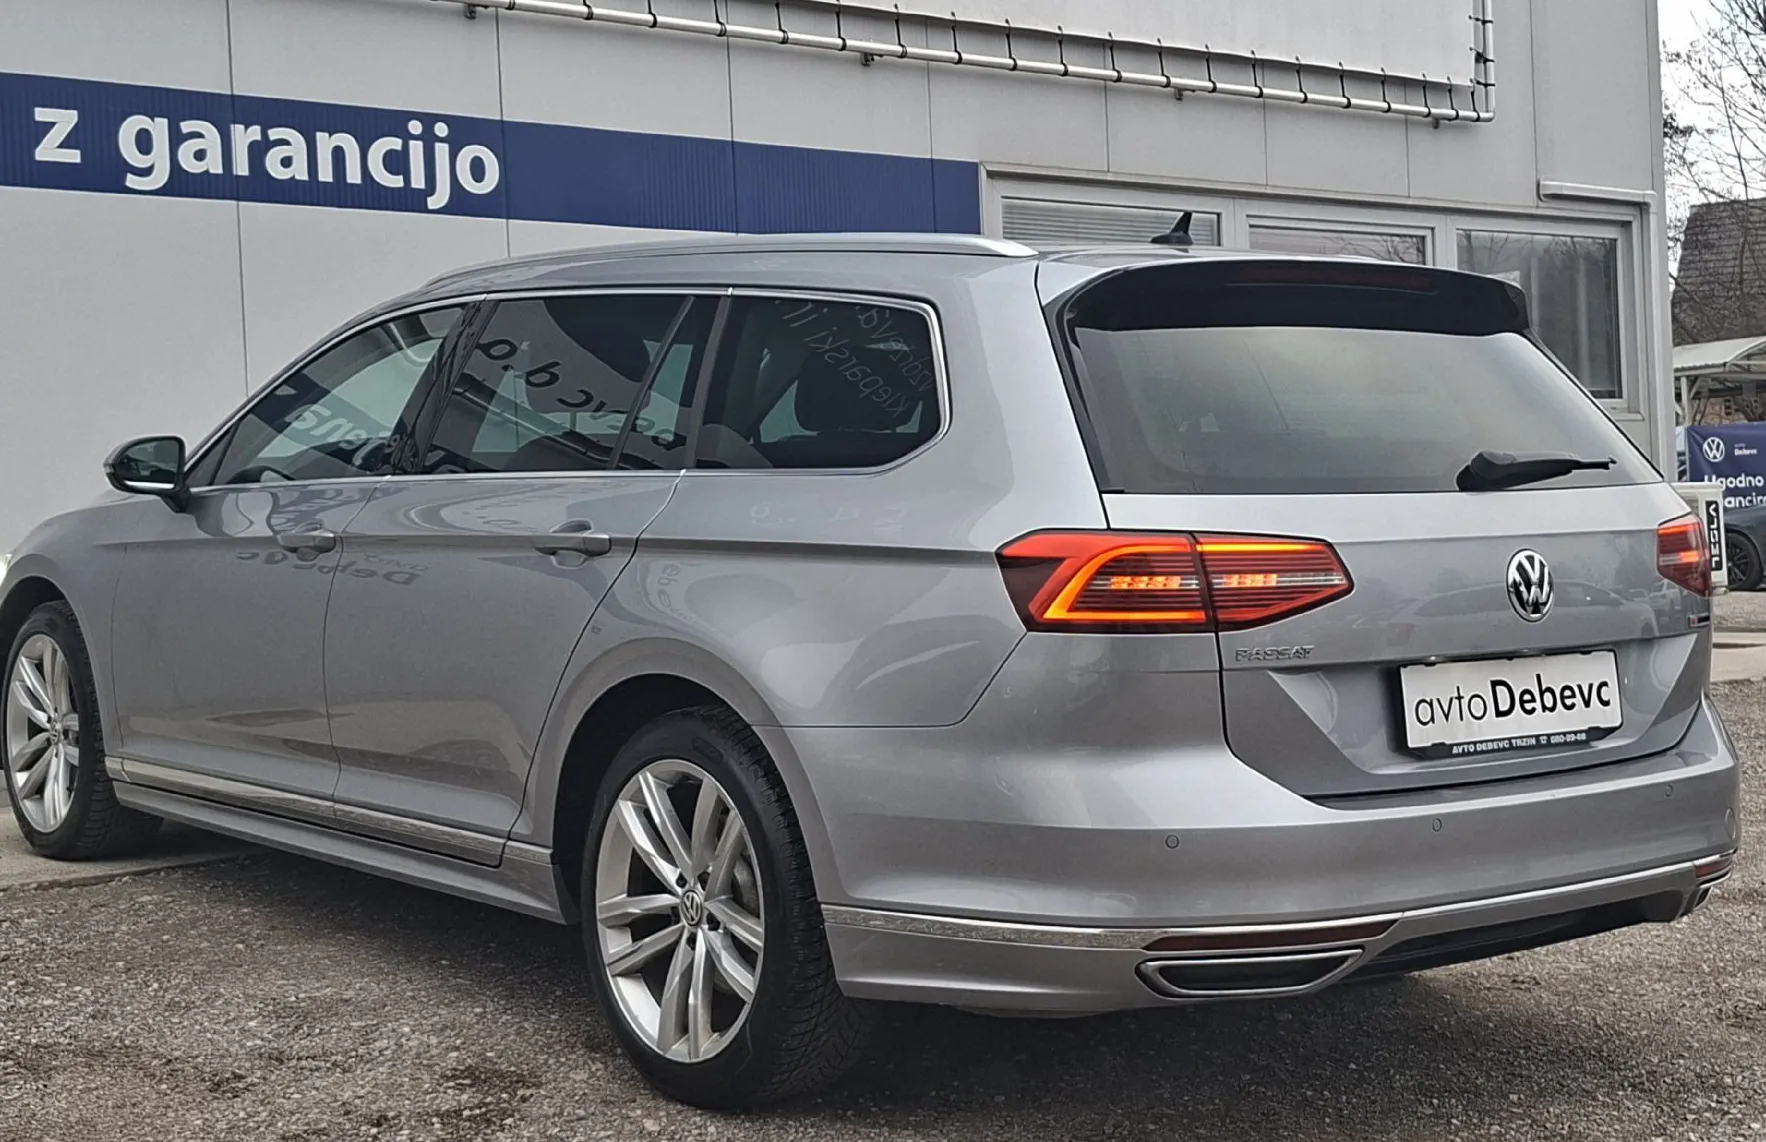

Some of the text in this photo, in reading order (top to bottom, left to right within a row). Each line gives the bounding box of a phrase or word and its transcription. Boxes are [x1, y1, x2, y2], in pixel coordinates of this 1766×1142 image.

[34, 107, 499, 210] z garancijo
[1235, 645, 1315, 662] PASSAT
[1452, 744, 1475, 754] AVTO
[1476, 741, 1510, 751] DEBEVC
[1511, 737, 1536, 748] TRZIN
